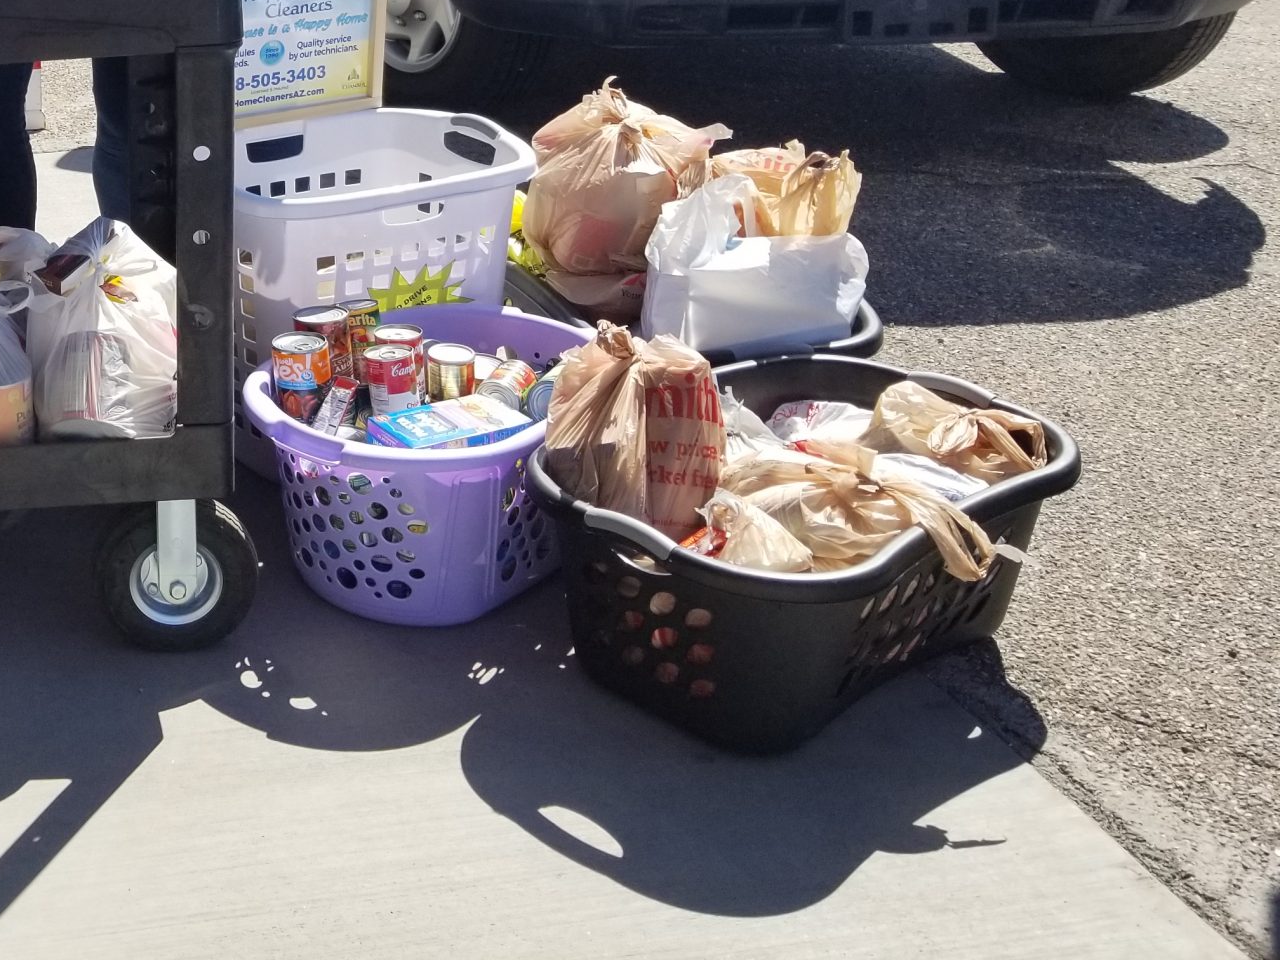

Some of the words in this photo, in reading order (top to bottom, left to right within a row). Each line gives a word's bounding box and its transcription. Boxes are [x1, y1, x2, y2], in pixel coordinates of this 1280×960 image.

[265, 0, 333, 19] Cleaners
[293, 17, 333, 32] Happy
[335, 12, 369, 26] Home
[296, 37, 325, 51] Quality
[325, 34, 352, 45] service
[288, 51, 298, 61] by
[299, 50, 313, 59] our
[314, 44, 359, 57] technicians.
[234, 58, 249, 68] eds.
[235, 64, 326, 91] 8-505-3403
[404, 284, 428, 305] DRIVE
[348, 313, 377, 327] arita
[645, 372, 724, 427] mith
